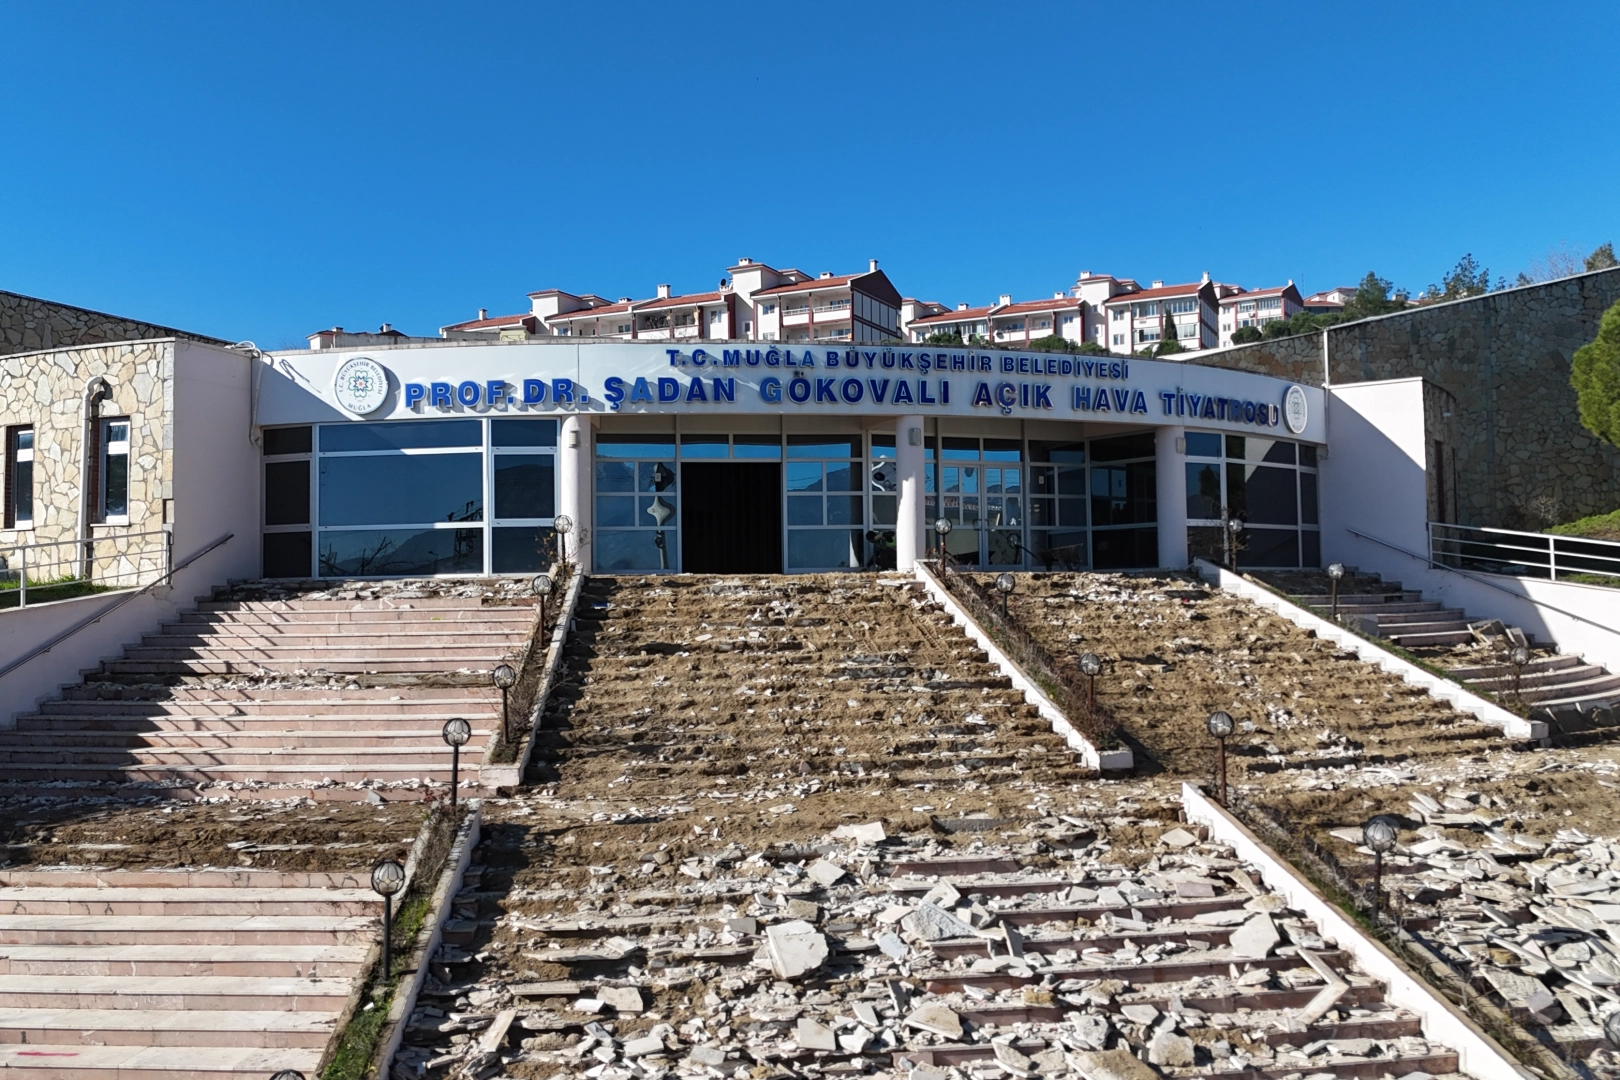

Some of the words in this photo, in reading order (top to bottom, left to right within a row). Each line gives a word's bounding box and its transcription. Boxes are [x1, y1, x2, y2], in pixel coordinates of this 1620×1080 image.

[826, 346, 992, 375] BÜYÜKŞEHİR
[1001, 356, 1130, 380] BELEDİYESİ
[603, 376, 736, 411] ŞADAN
[759, 370, 950, 404] GÖKOVALI
[972, 382, 1054, 415] AÇIK
[1072, 385, 1149, 414] HAVA
[1160, 387, 1279, 427] TİYATROSU
